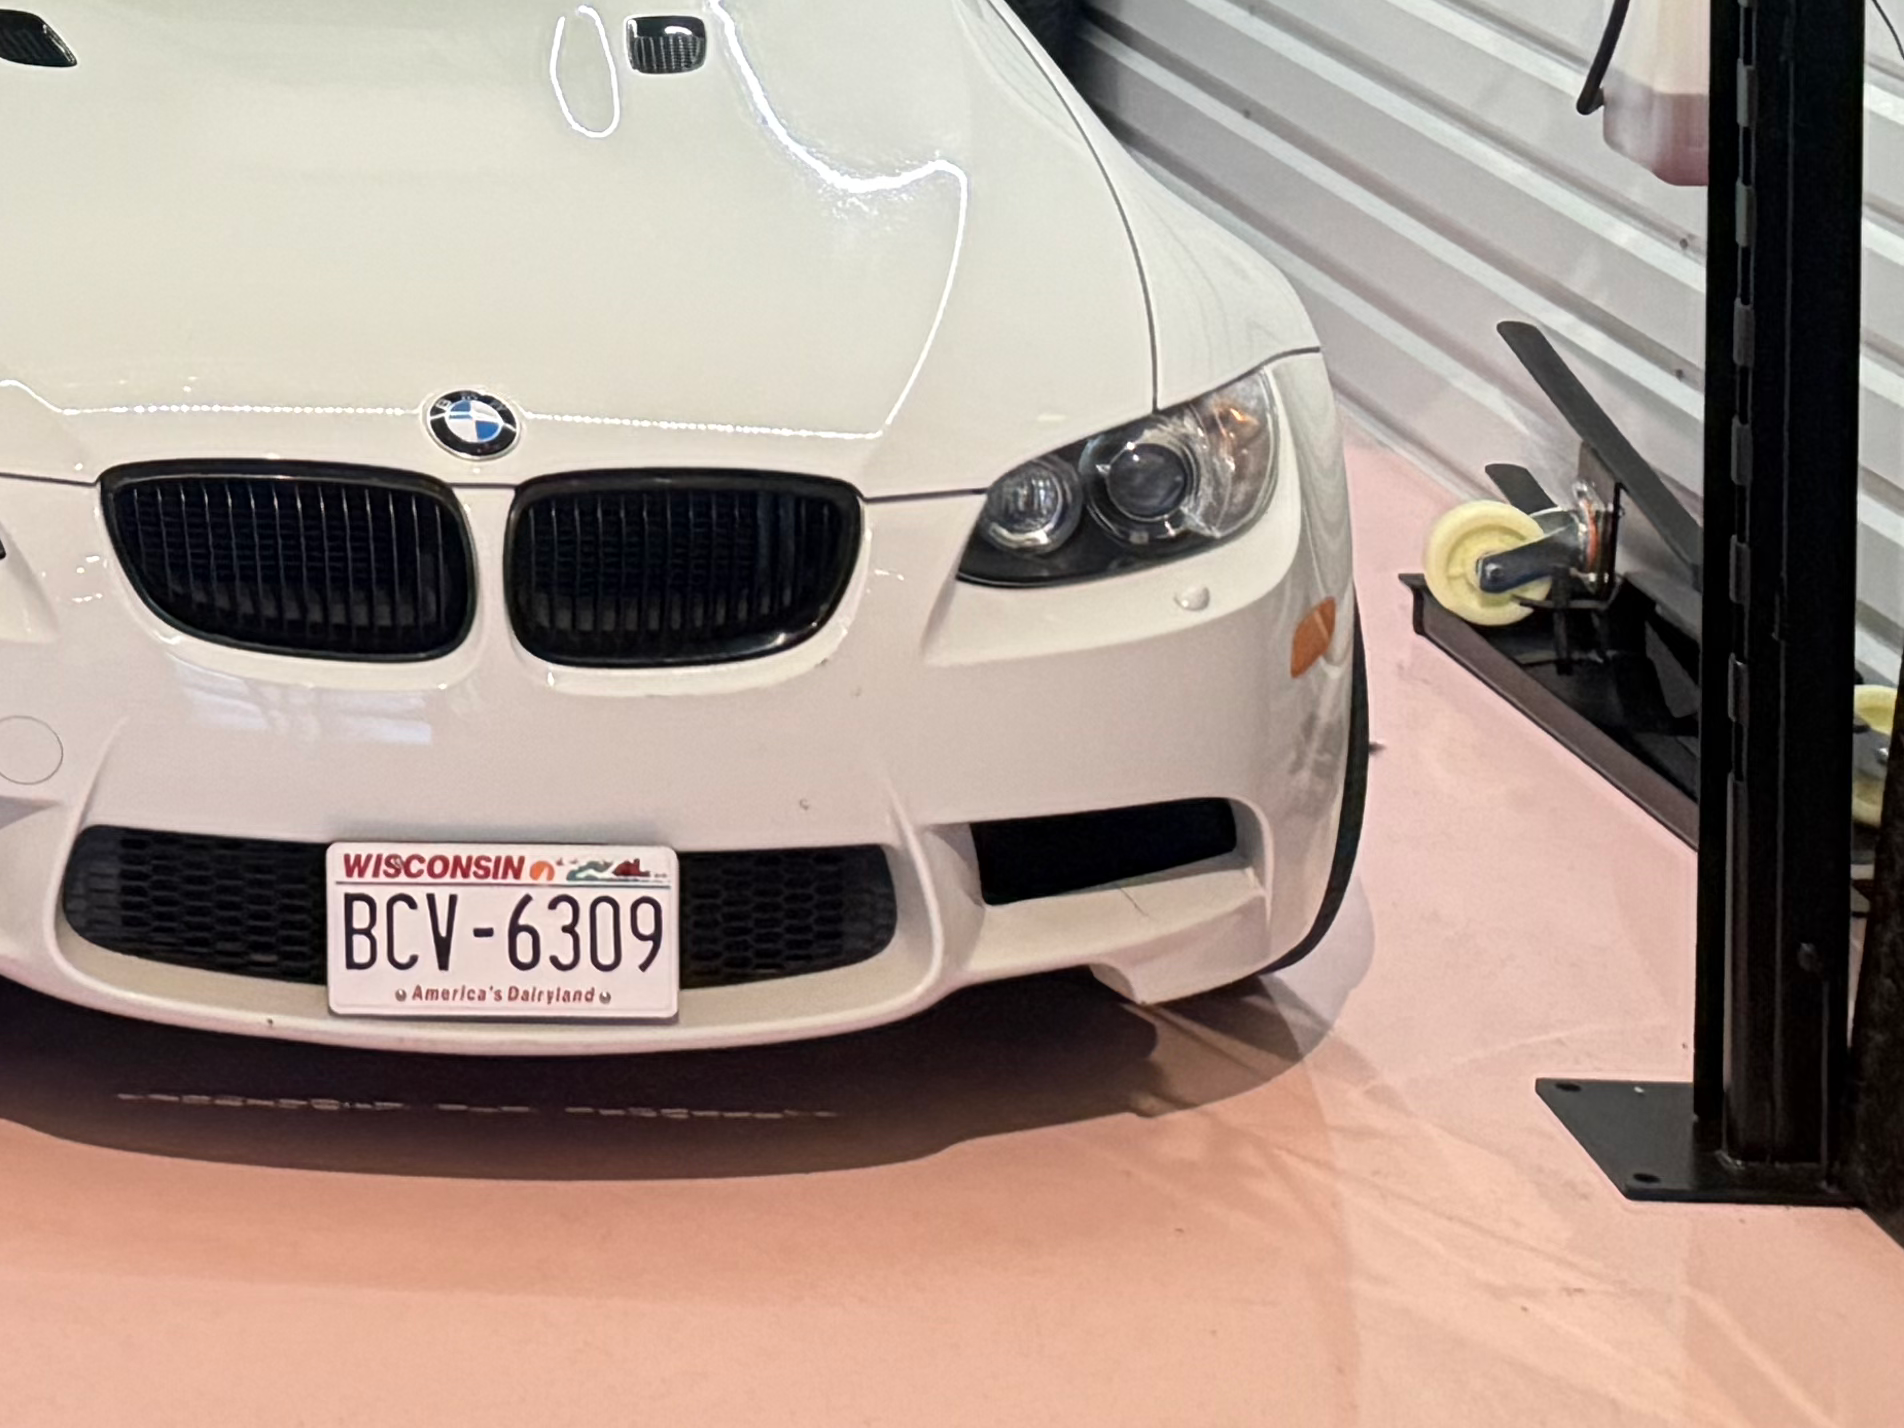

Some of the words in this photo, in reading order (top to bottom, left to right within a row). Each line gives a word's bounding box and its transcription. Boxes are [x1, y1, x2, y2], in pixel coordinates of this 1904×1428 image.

[343, 853, 526, 880] WISCONSIN
[344, 892, 663, 973] BCV-6309
[412, 985, 503, 1003] America's
[507, 985, 596, 1005] Dairyland
